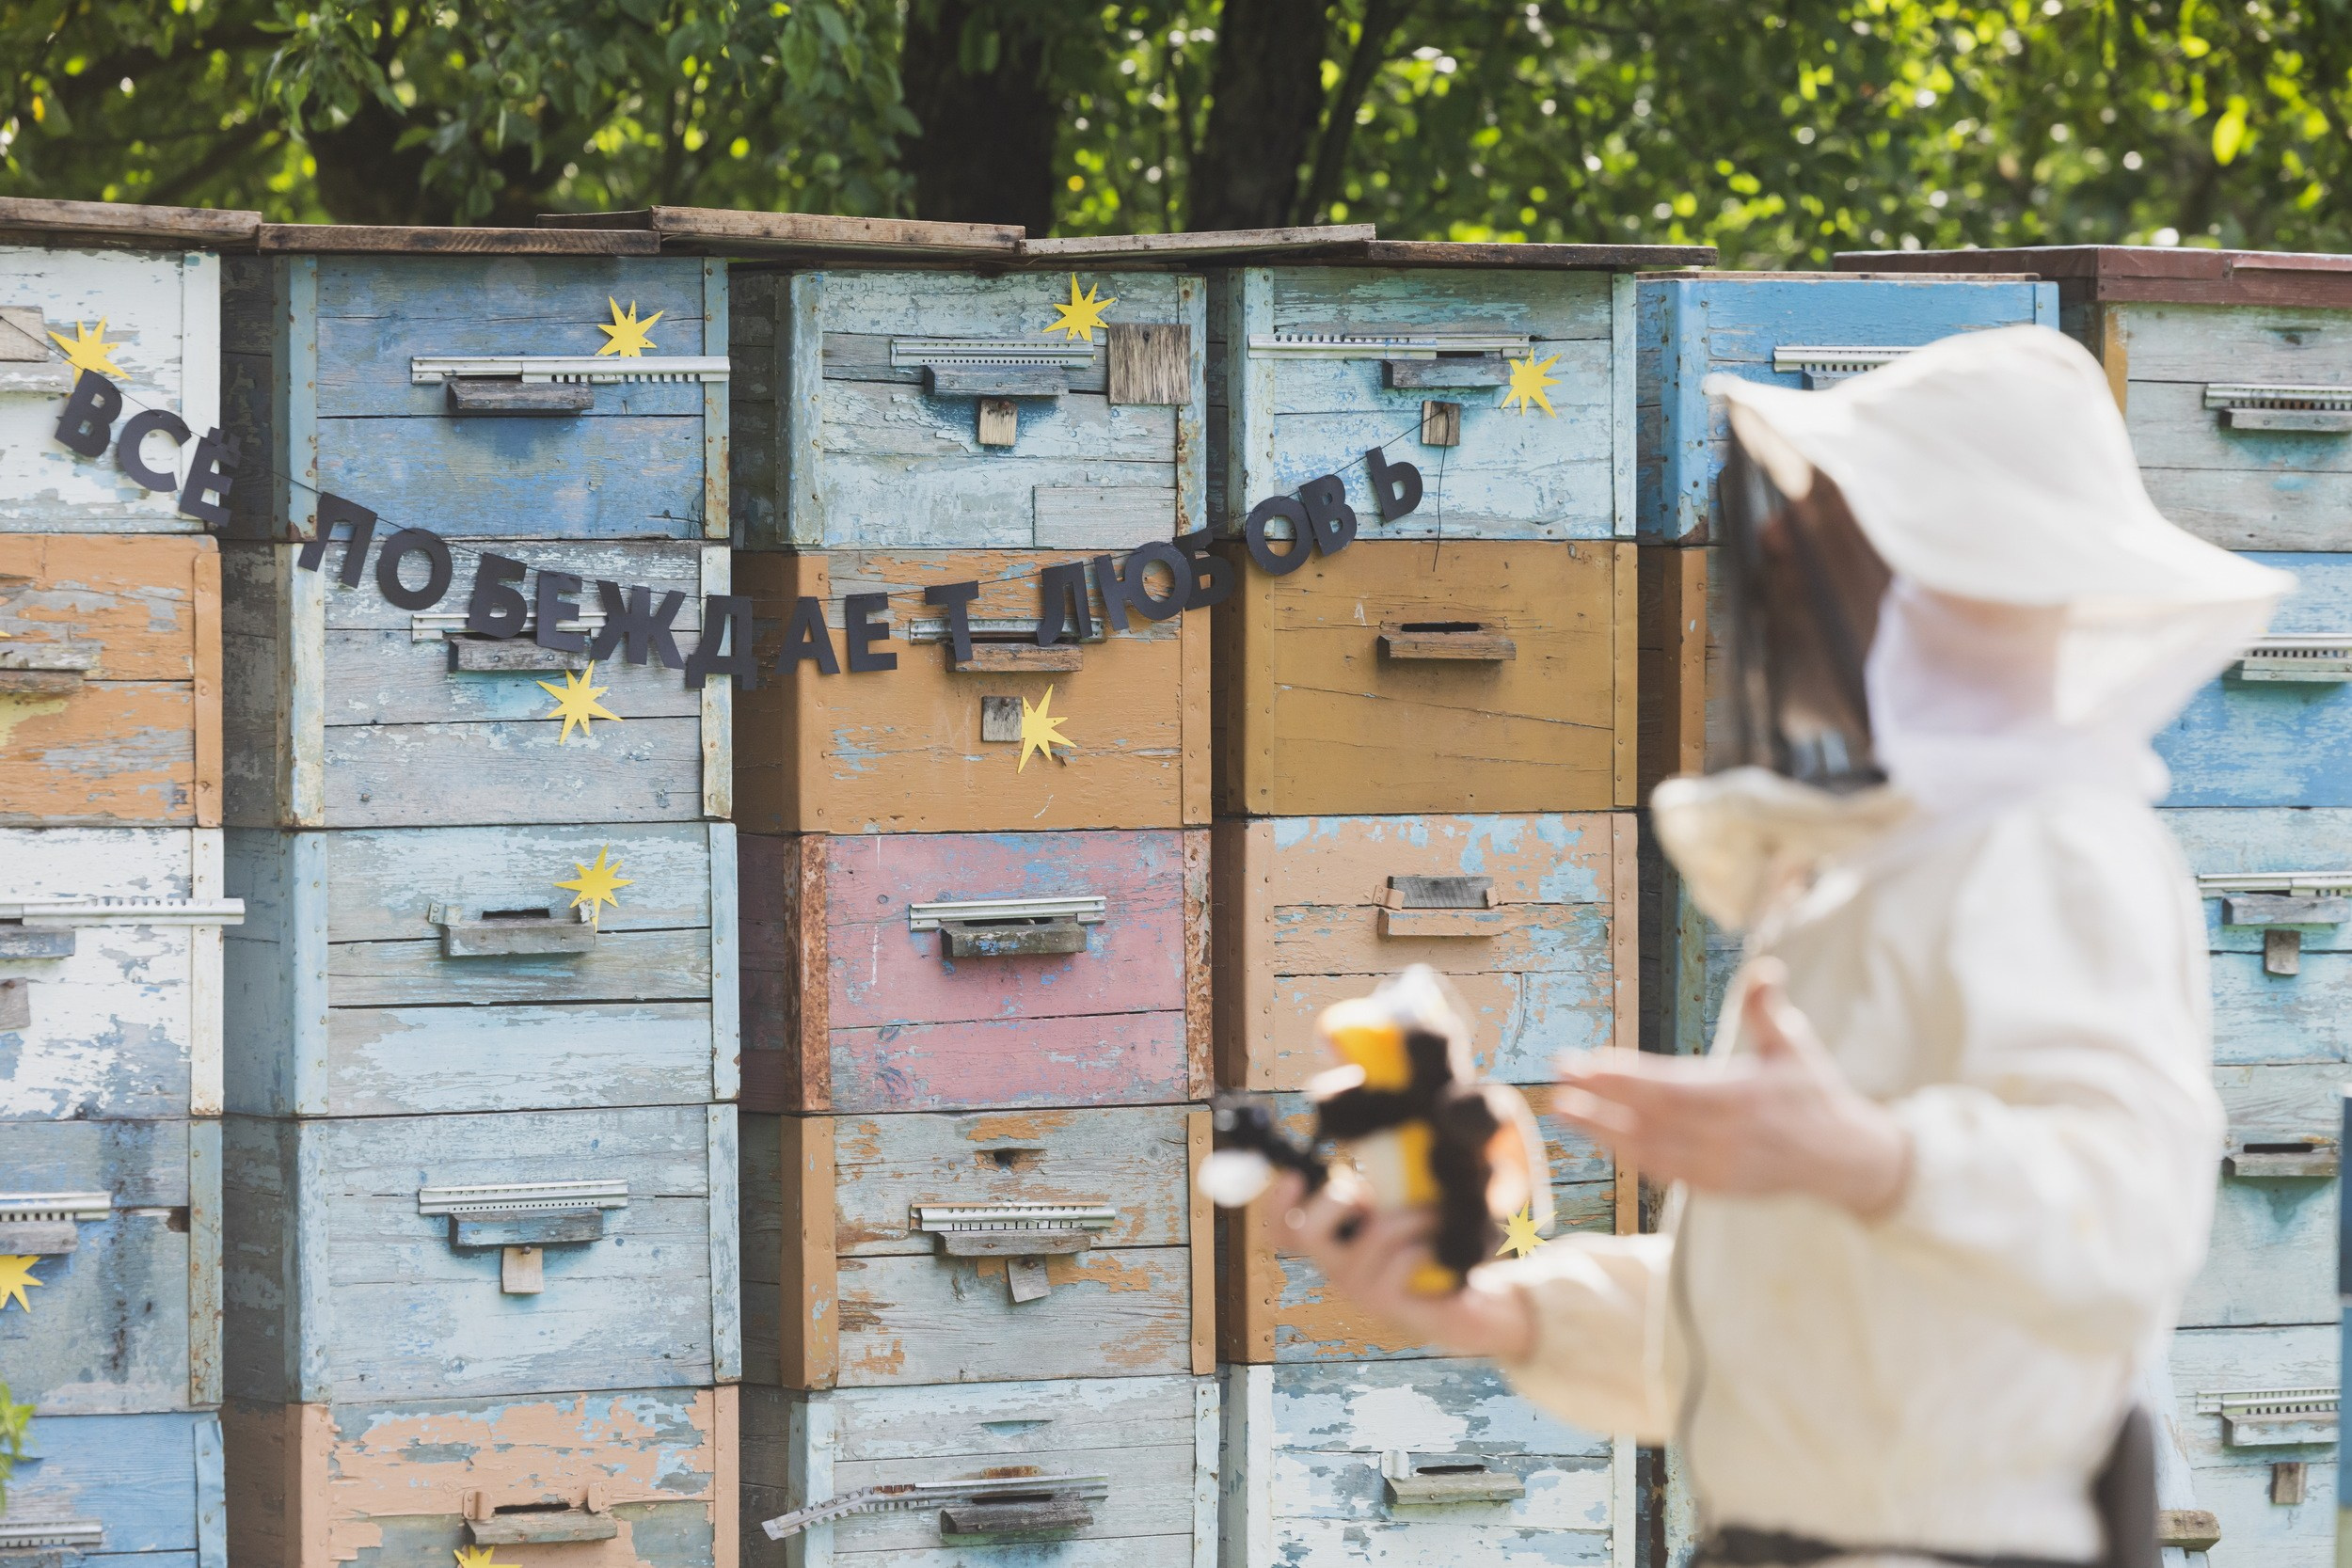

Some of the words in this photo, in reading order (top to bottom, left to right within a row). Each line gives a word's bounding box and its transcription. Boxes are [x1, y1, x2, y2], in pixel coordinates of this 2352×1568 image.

[55, 368, 241, 527] ВСЁ
[298, 492, 979, 689] ПОБЕЖДАЕТ
[1037, 447, 1423, 646] ЛЮБОВЬ
